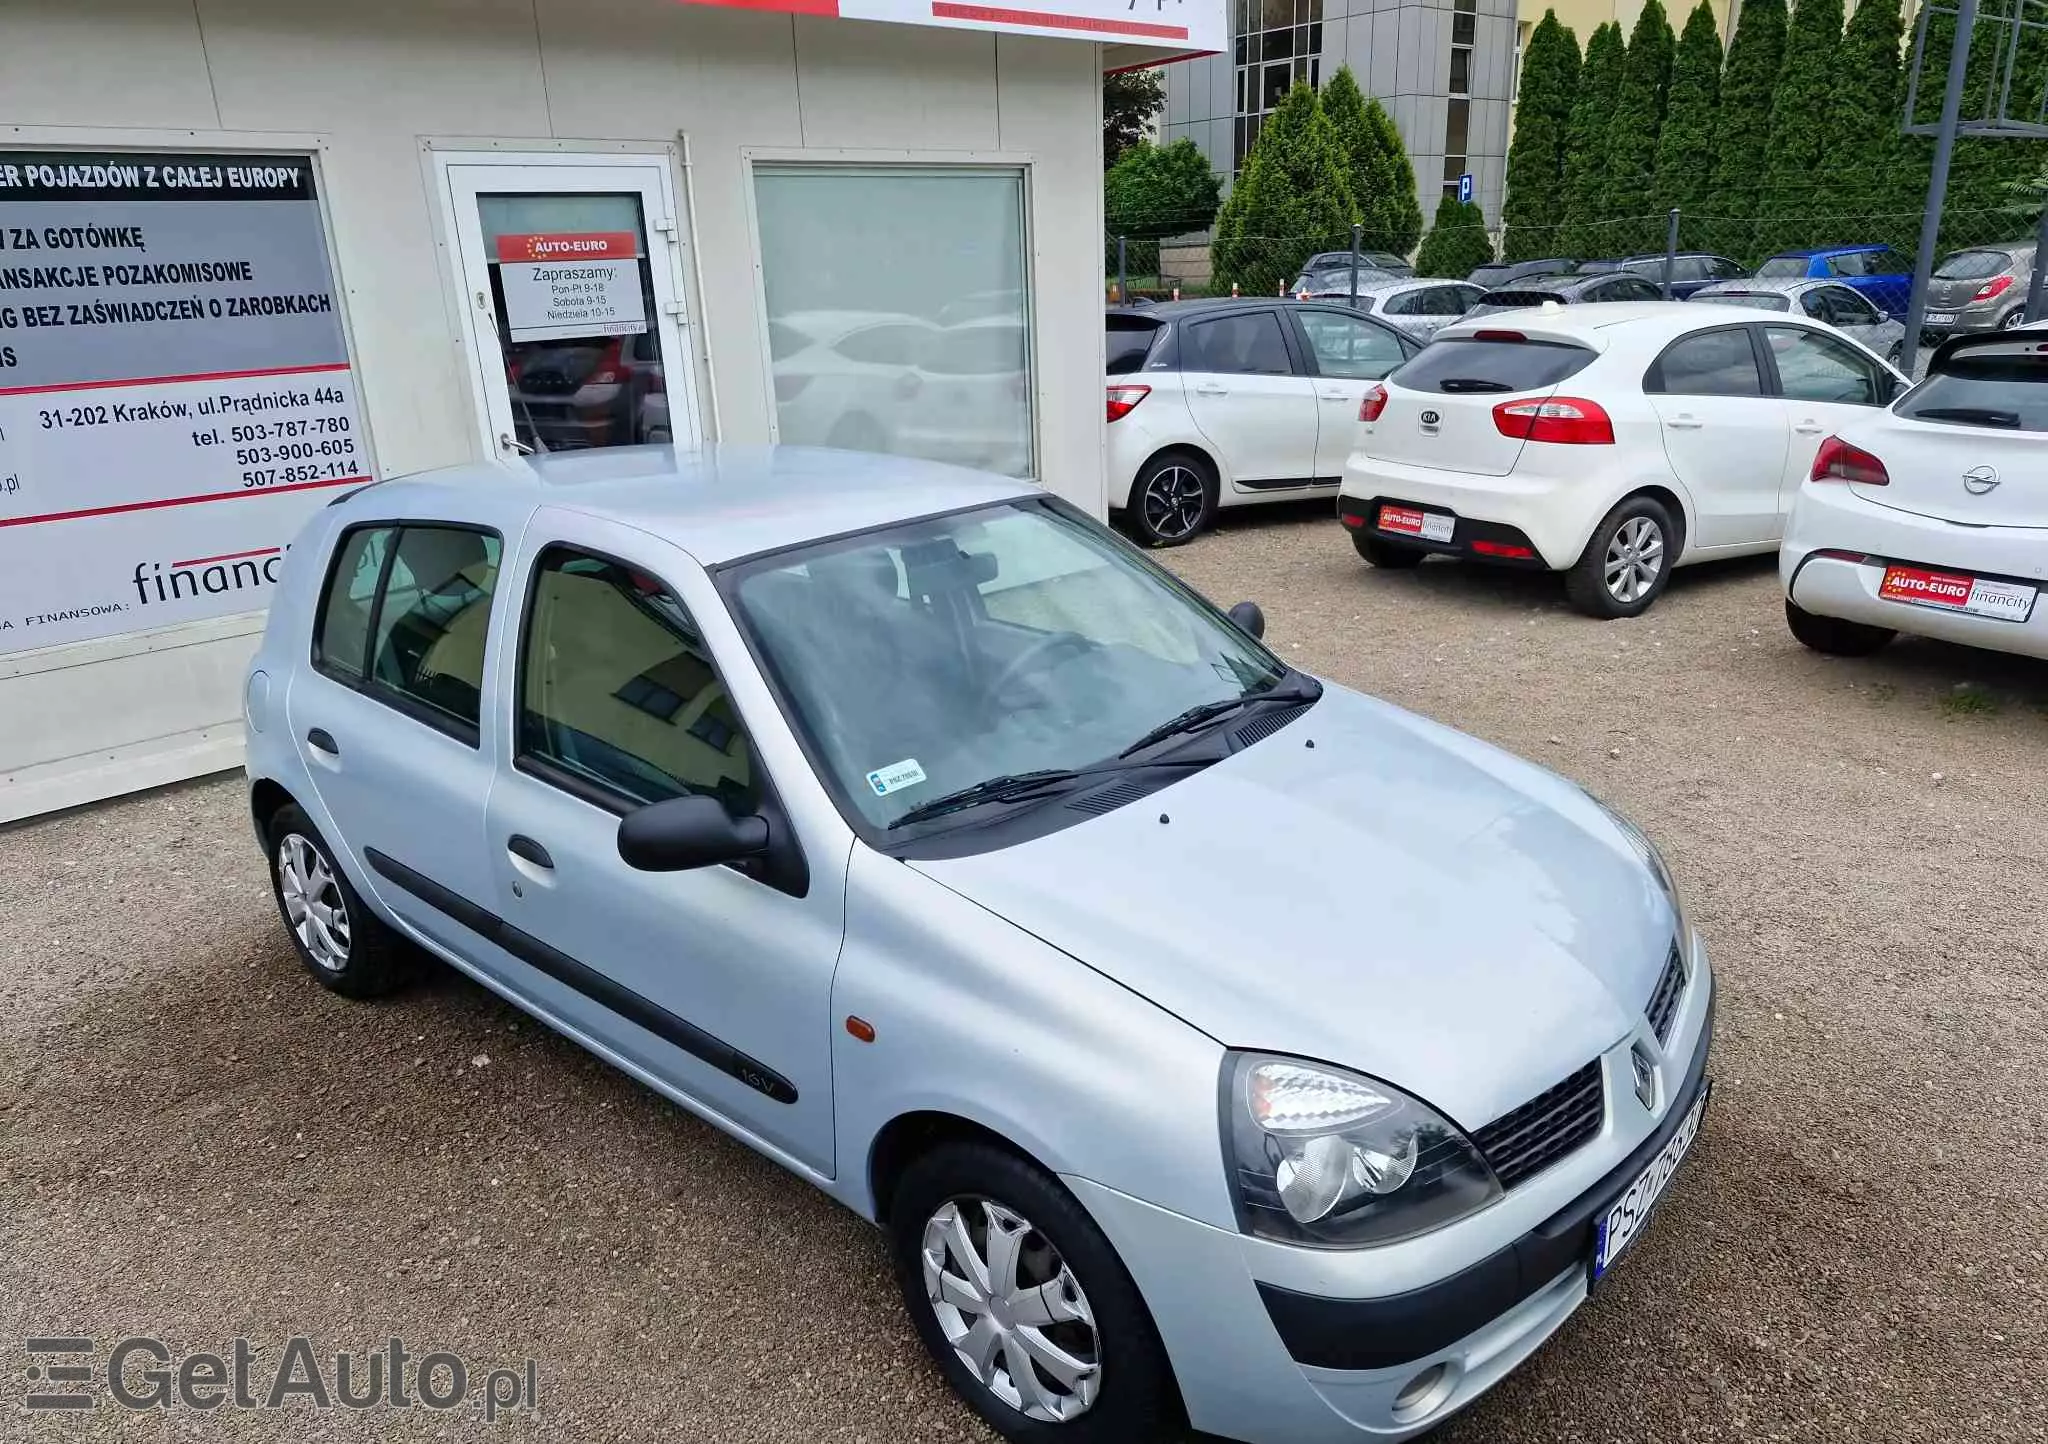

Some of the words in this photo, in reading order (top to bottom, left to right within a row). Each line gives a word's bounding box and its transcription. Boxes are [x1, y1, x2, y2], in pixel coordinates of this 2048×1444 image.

[24, 161, 140, 188] POJAZDÓW
[143, 166, 160, 188] Z
[162, 167, 223, 188] CAŁEJ
[228, 167, 299, 188] EUROPY
[9, 228, 41, 249] ZA
[43, 222, 146, 253] GOTÓWKĘ
[535, 241, 608, 253] AUTO-EURO
[103, 261, 253, 286] POZAKOMISOWE
[533, 267, 617, 283] Zapraszamy:
[551, 284, 582, 295] Pon-Pt
[553, 297, 585, 307] Sobota
[587, 295, 607, 305] 9-15
[22, 306, 65, 327] BEZ
[67, 294, 205, 325] ZAŚWIADCZEŃ
[209, 299, 222, 317] O
[228, 294, 332, 317] ZAROBKACH
[40, 406, 108, 429] 31-202
[113, 400, 193, 423] Kraków,
[198, 389, 310, 416] ul.Prądnicka
[314, 387, 344, 404] 44a
[192, 429, 225, 447] tel.
[231, 416, 350, 443] 503-787-780
[236, 439, 354, 465] 503-900-605
[242, 460, 358, 487] 507-852-114
[1384, 513, 1420, 527] AUTO-EURO
[1892, 576, 1967, 597] AUTO-EURO
[1970, 587, 2031, 612] financity
[25, 603, 130, 626] FINANSOWA:
